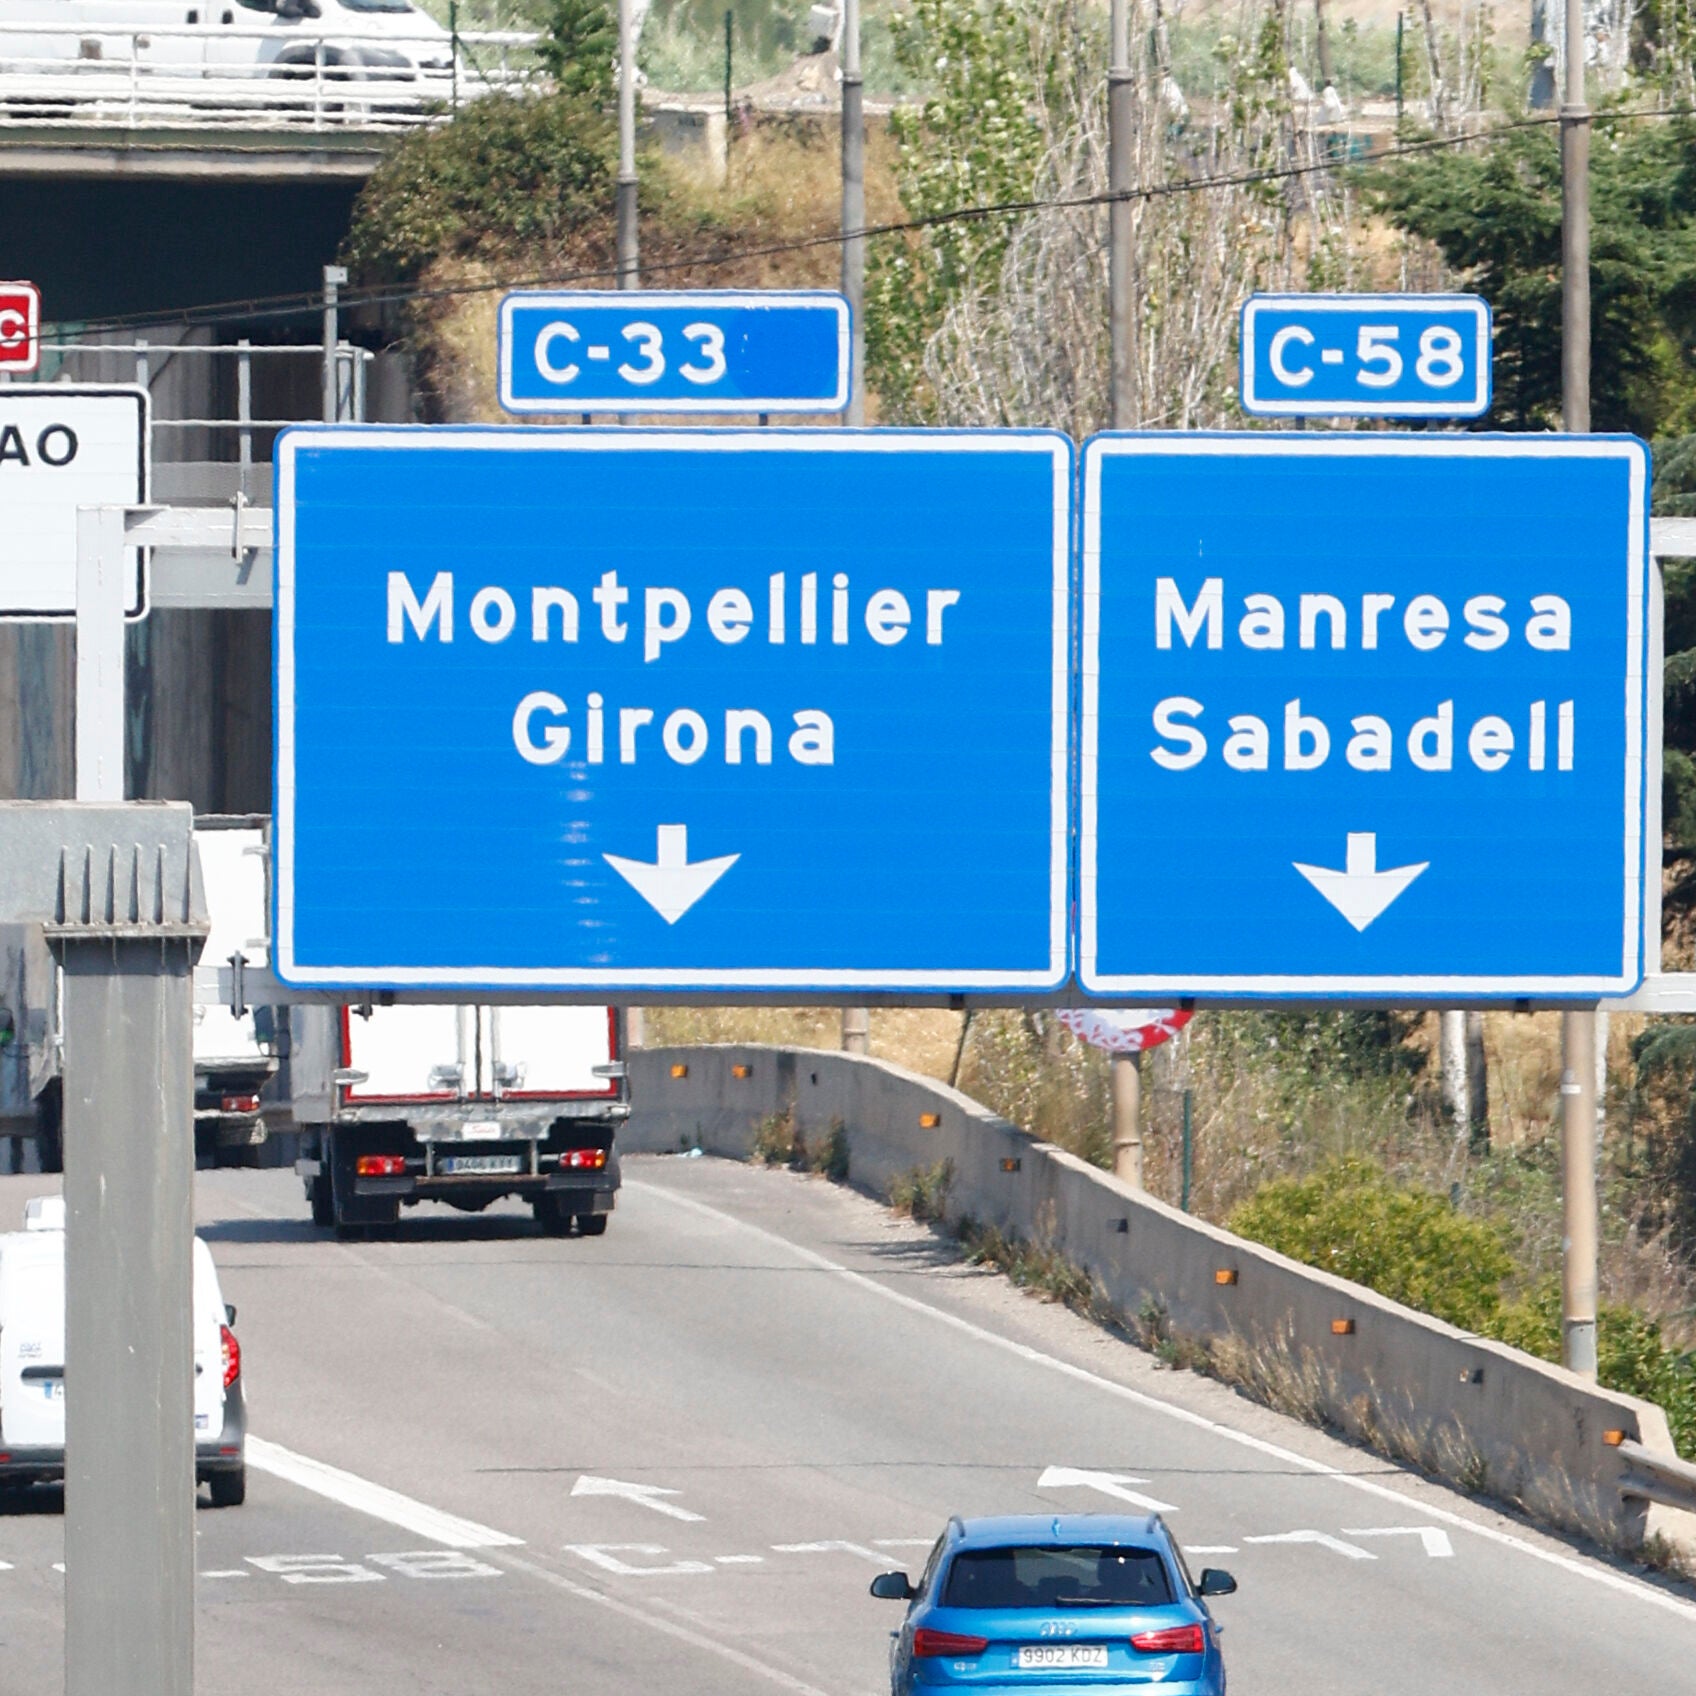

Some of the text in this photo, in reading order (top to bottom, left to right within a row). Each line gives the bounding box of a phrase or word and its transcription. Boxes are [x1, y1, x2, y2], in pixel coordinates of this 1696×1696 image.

[534, 322, 728, 386] C-33
[1269, 325, 1466, 388] C-58
[387, 569, 961, 663] Montpellier
[1154, 577, 1573, 652] Manresa
[512, 691, 835, 766] Girona
[1149, 695, 1575, 772] Sabadell
[1023, 1646, 1102, 1664] 9902 KDZ
